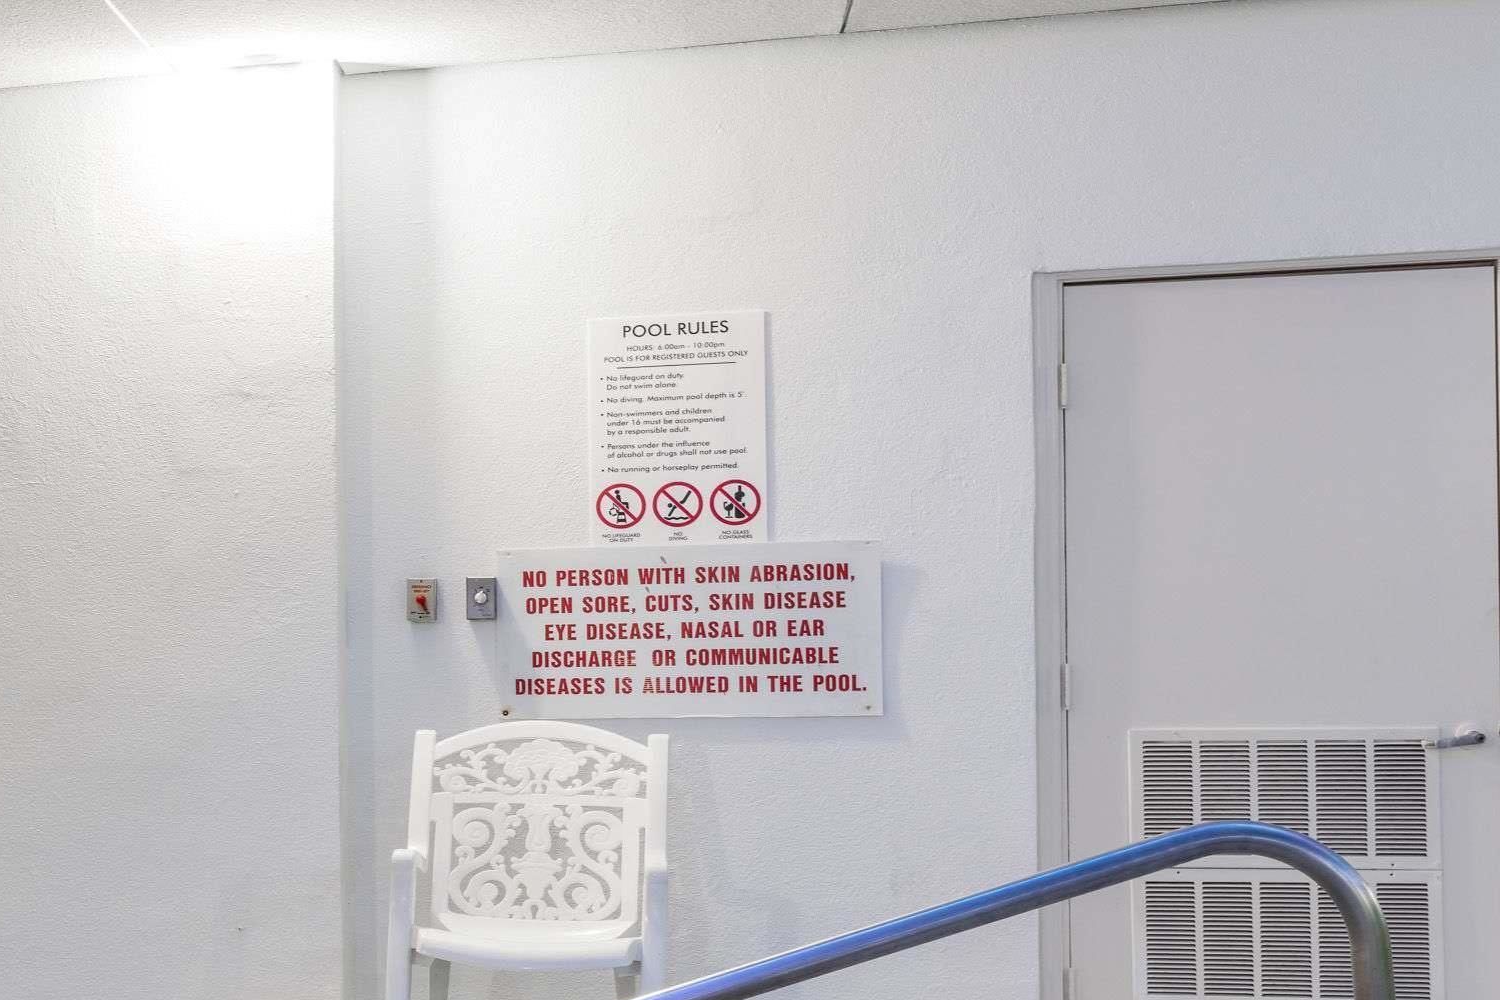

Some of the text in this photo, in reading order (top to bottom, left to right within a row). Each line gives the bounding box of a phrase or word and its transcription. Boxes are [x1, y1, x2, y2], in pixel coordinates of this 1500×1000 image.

[623, 320, 729, 338] POOL RULES
[636, 354, 650, 362] FOR
[652, 352, 695, 361] REGISTERED
[697, 351, 726, 359] GUESTS
[728, 350, 748, 358] ONLY
[620, 373, 653, 383] lifeguard
[647, 394, 684, 402] Maximum
[686, 392, 703, 401] pool
[705, 391, 727, 400] depth
[606, 407, 712, 418] Non-swimmers and children
[606, 419, 629, 427] under
[663, 417, 673, 425] be
[675, 415, 725, 424] accompanied
[625, 426, 667, 436] responsible
[670, 425, 691, 433] adult.
[638, 441, 659, 449] under
[675, 439, 710, 447] influence
[607, 451, 615, 459] of
[617, 451, 644, 459] alcohol
[656, 450, 678, 458] drugs
[680, 448, 697, 456] shall
[663, 463, 699, 471] horseplay
[701, 460, 739, 471] permitted.
[521, 562, 856, 588] NO PERSON WITH SKIN ABRASION,
[525, 590, 847, 615] OPEN SORE, CUTS, SKIN DISEASE
[543, 619, 825, 642] EYE DISEASE, NASAL OR EAR
[531, 646, 840, 669] DISCHARGE OR COMMUNICABLE
[514, 673, 868, 696] DISEASES IS ALLOWED IN THE POOL.
